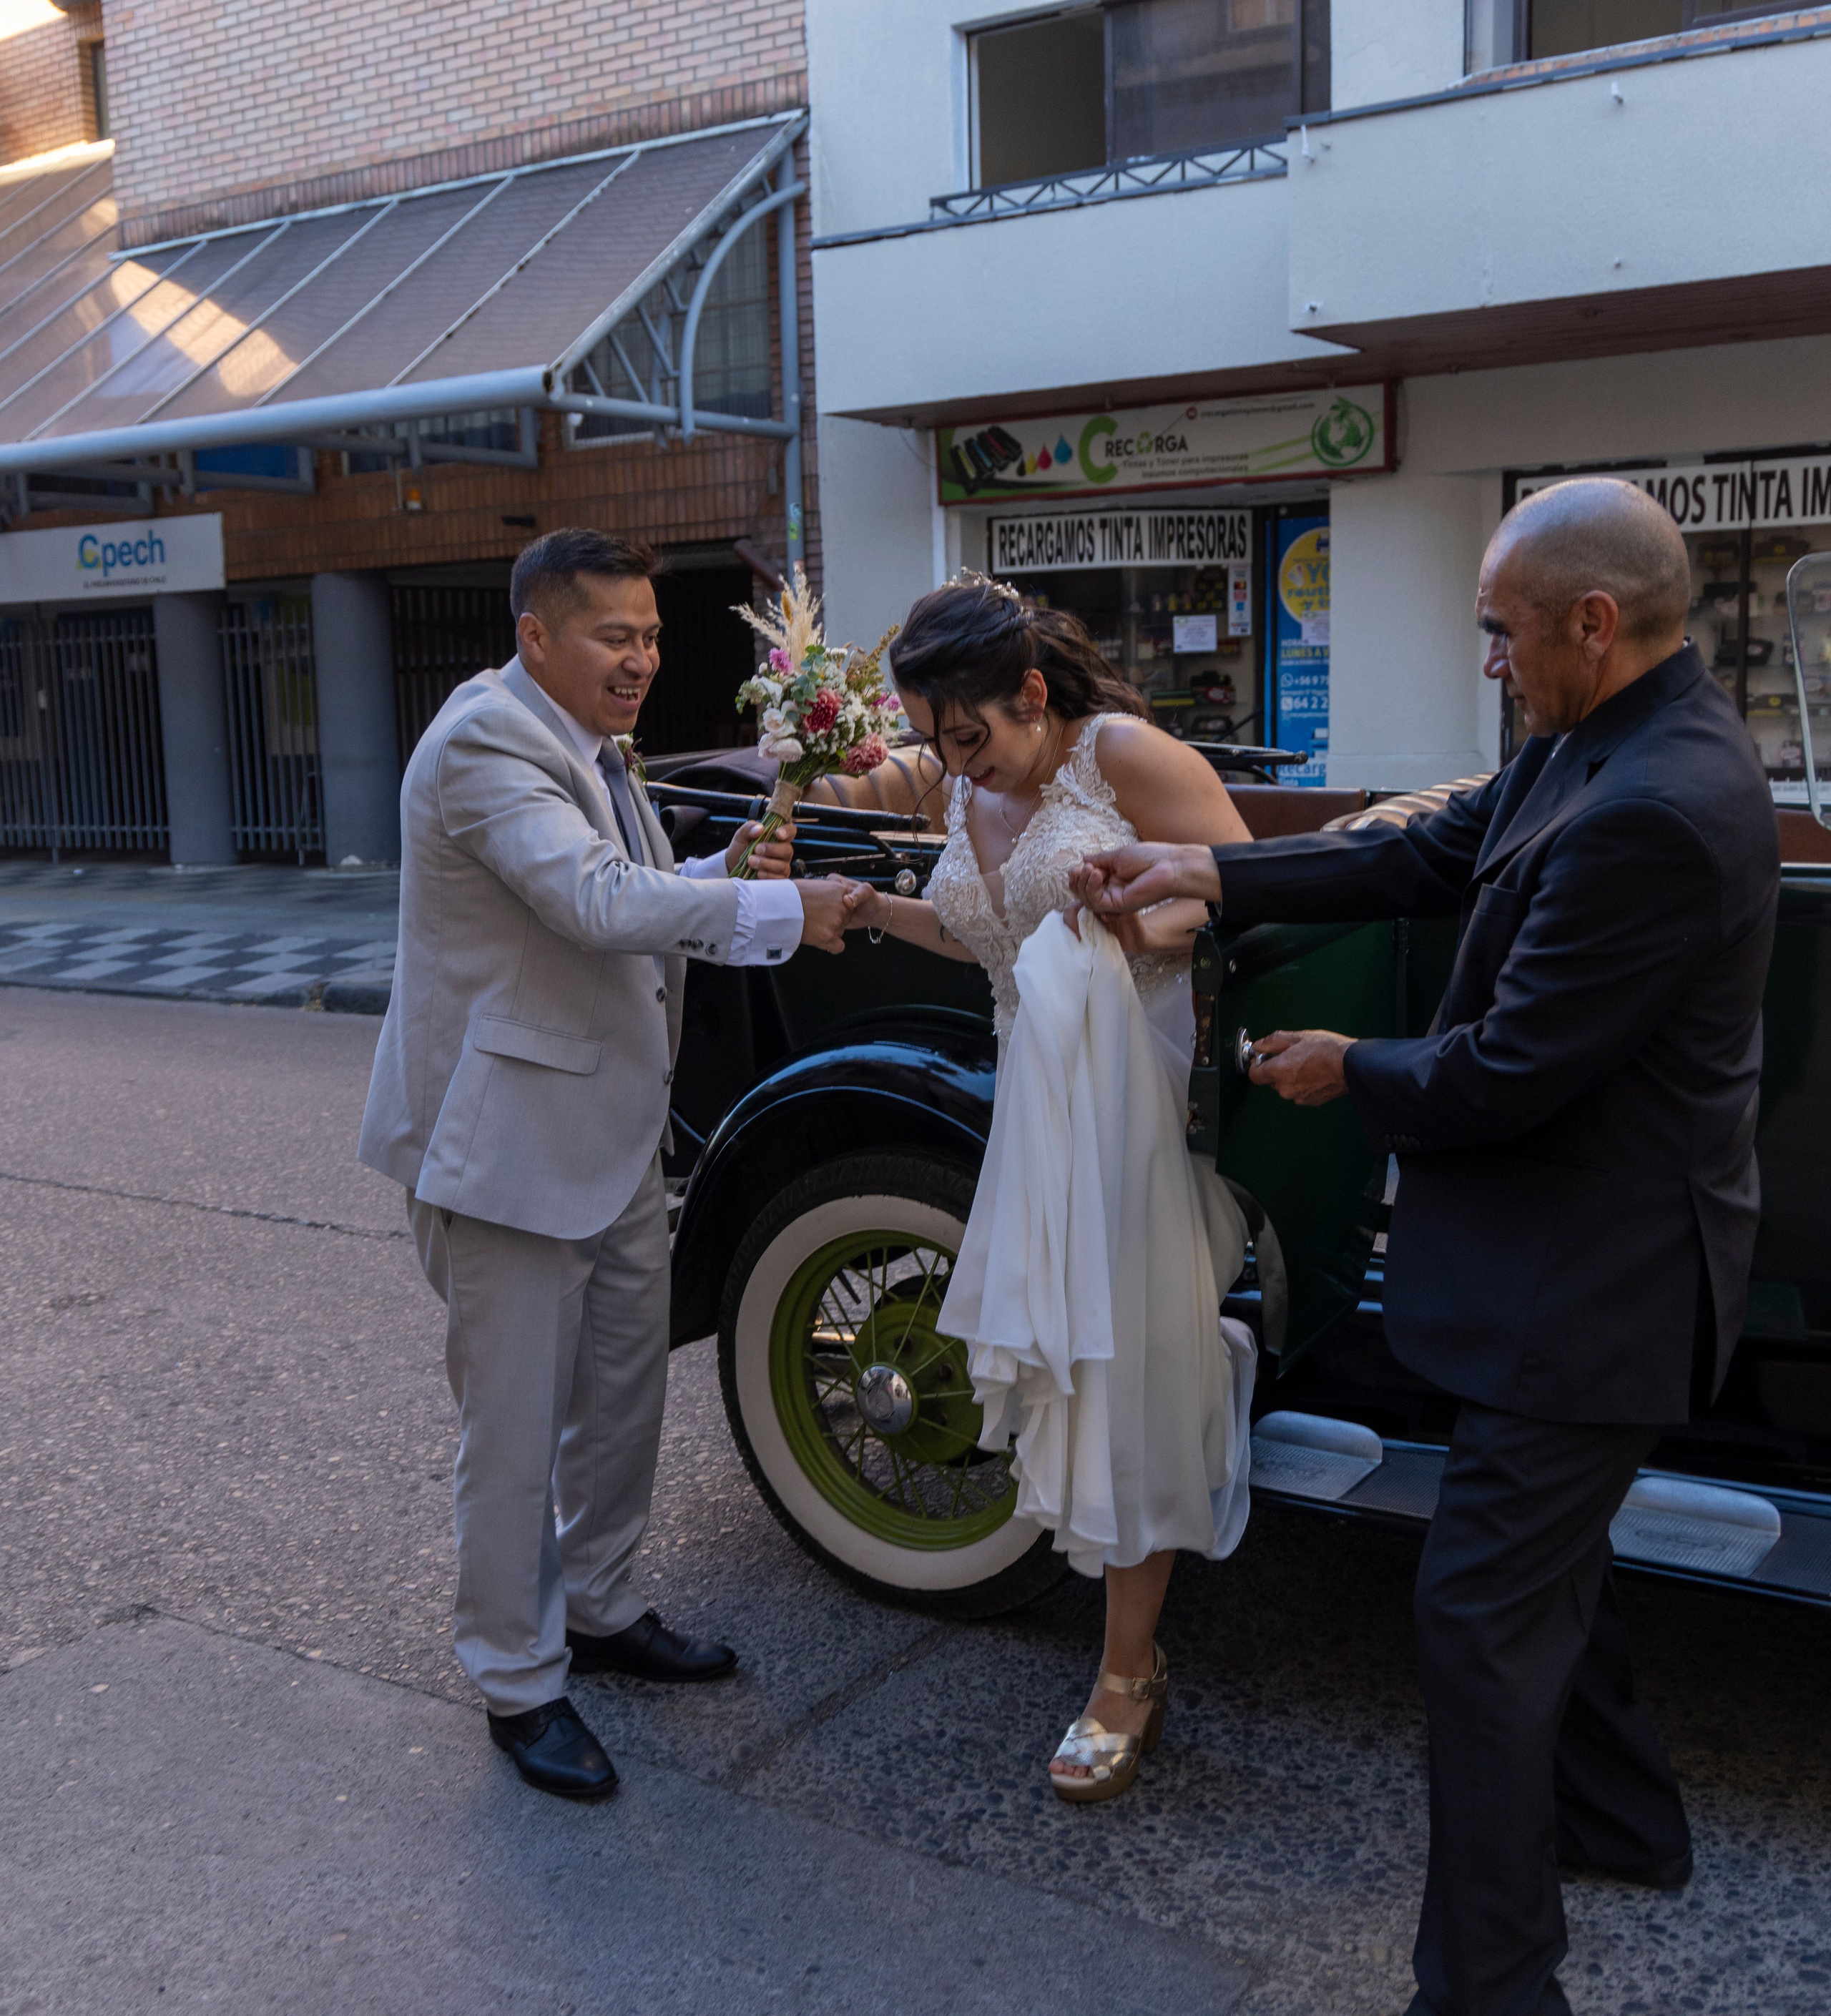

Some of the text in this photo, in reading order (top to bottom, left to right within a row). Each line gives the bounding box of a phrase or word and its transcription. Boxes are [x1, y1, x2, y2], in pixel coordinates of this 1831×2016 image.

[1712, 468, 1793, 523] TINTA
[78, 529, 165, 576] Cpech
[998, 514, 1247, 567] RECARGAMOS TINTA IMPRESORAS
[1280, 647, 1312, 659] LUNES
[1294, 697, 1308, 710] 64
